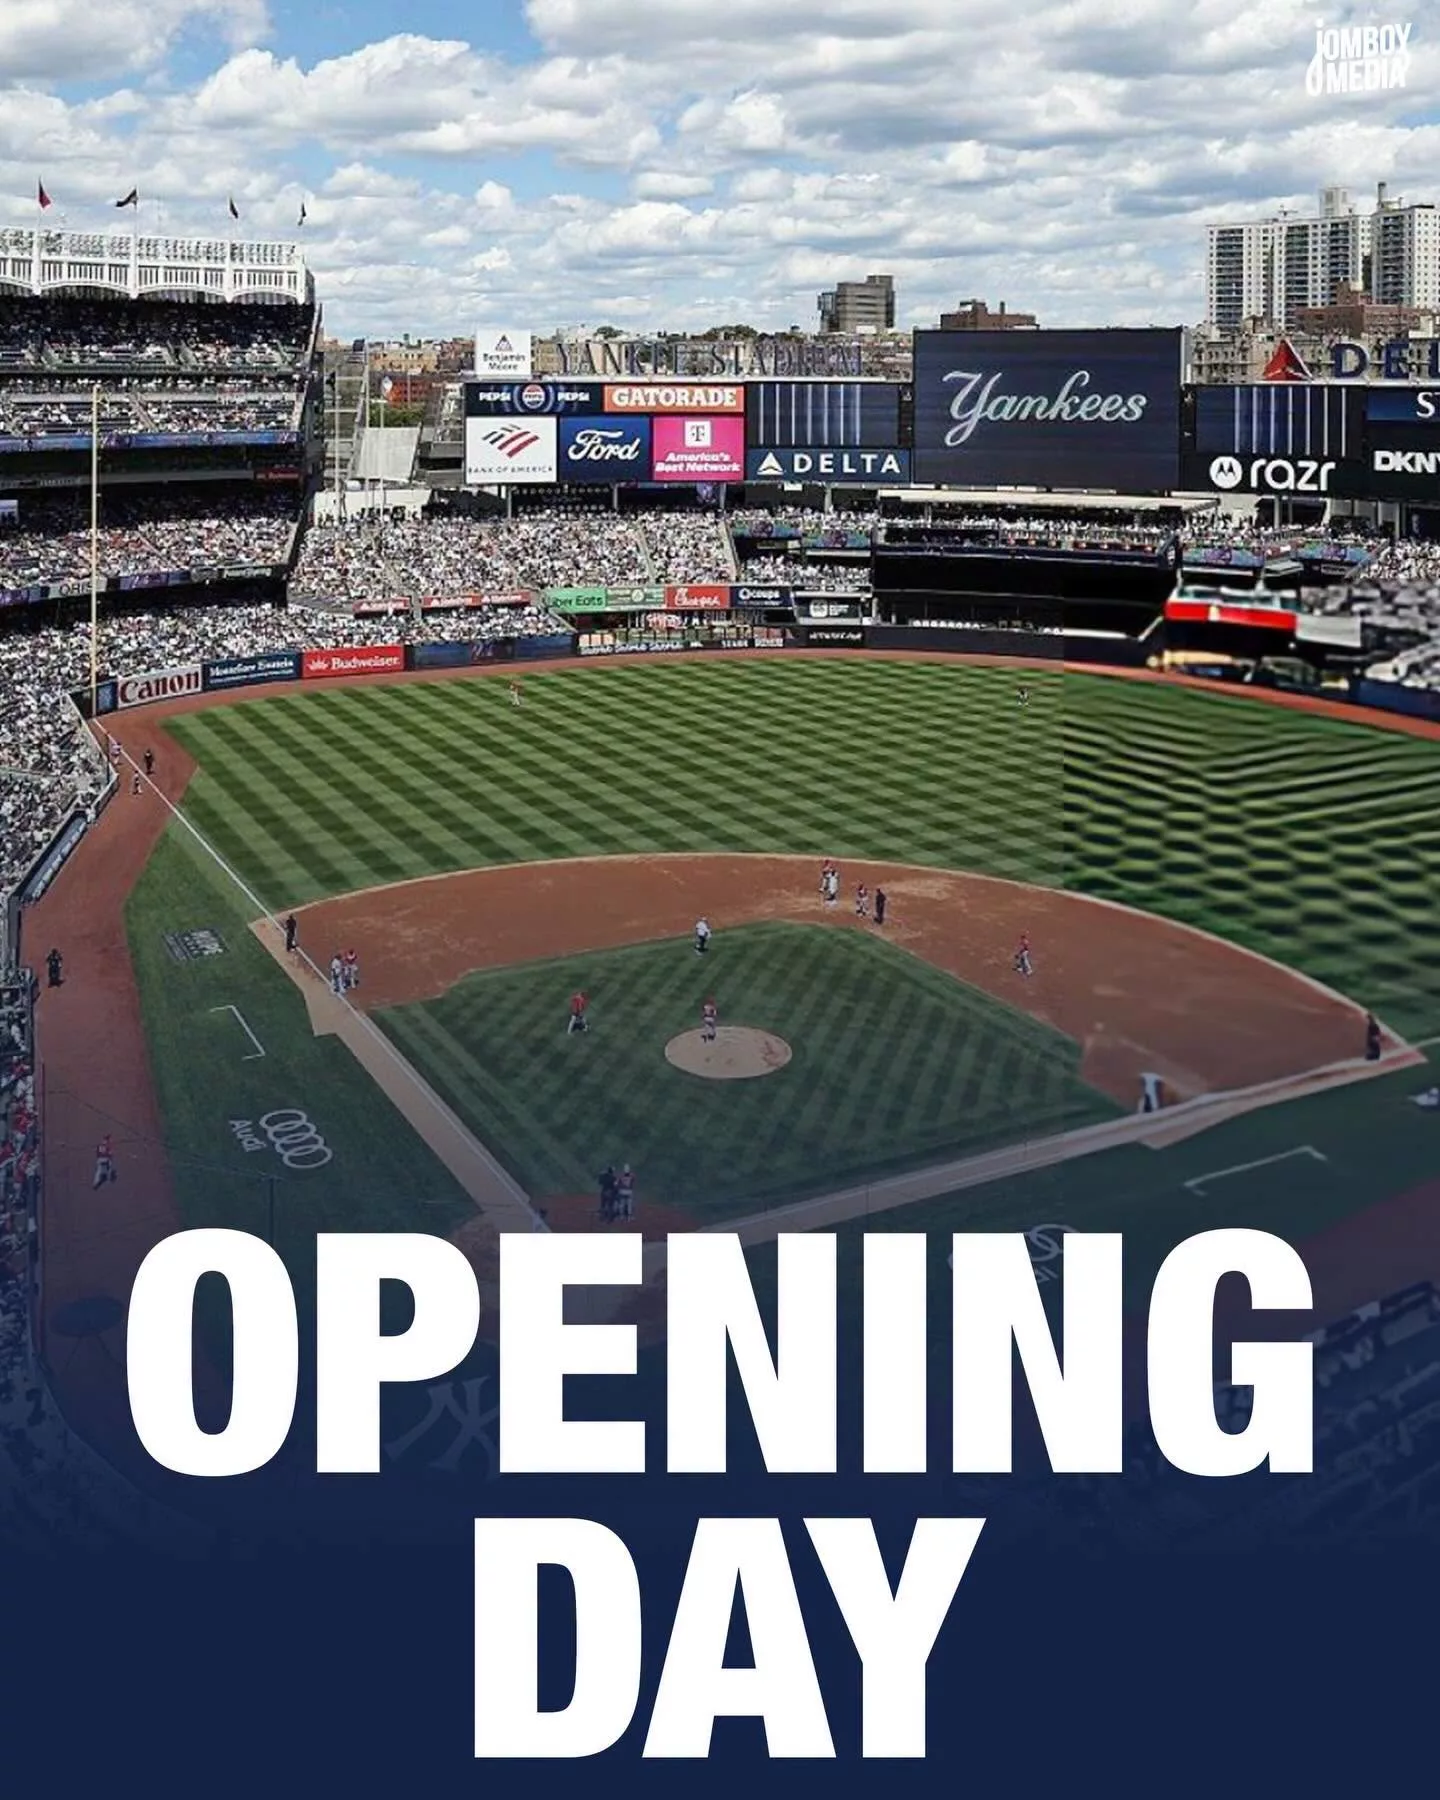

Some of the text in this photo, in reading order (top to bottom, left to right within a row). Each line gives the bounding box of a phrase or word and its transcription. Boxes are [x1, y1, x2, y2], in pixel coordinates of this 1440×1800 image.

[479, 391, 511, 402] PEPSI
[557, 391, 590, 402] PEPSI
[612, 387, 737, 407] GATORADE
[943, 370, 1147, 447] Yankees
[568, 429, 640, 461] Ford
[655, 462, 740, 472] Best Network
[665, 452, 731, 462] America's
[794, 453, 900, 474] DELTA
[1250, 458, 1336, 491] razr
[331, 654, 399, 672] Budweiser
[119, 670, 199, 704] Canon
[229, 1119, 267, 1152] Audi
